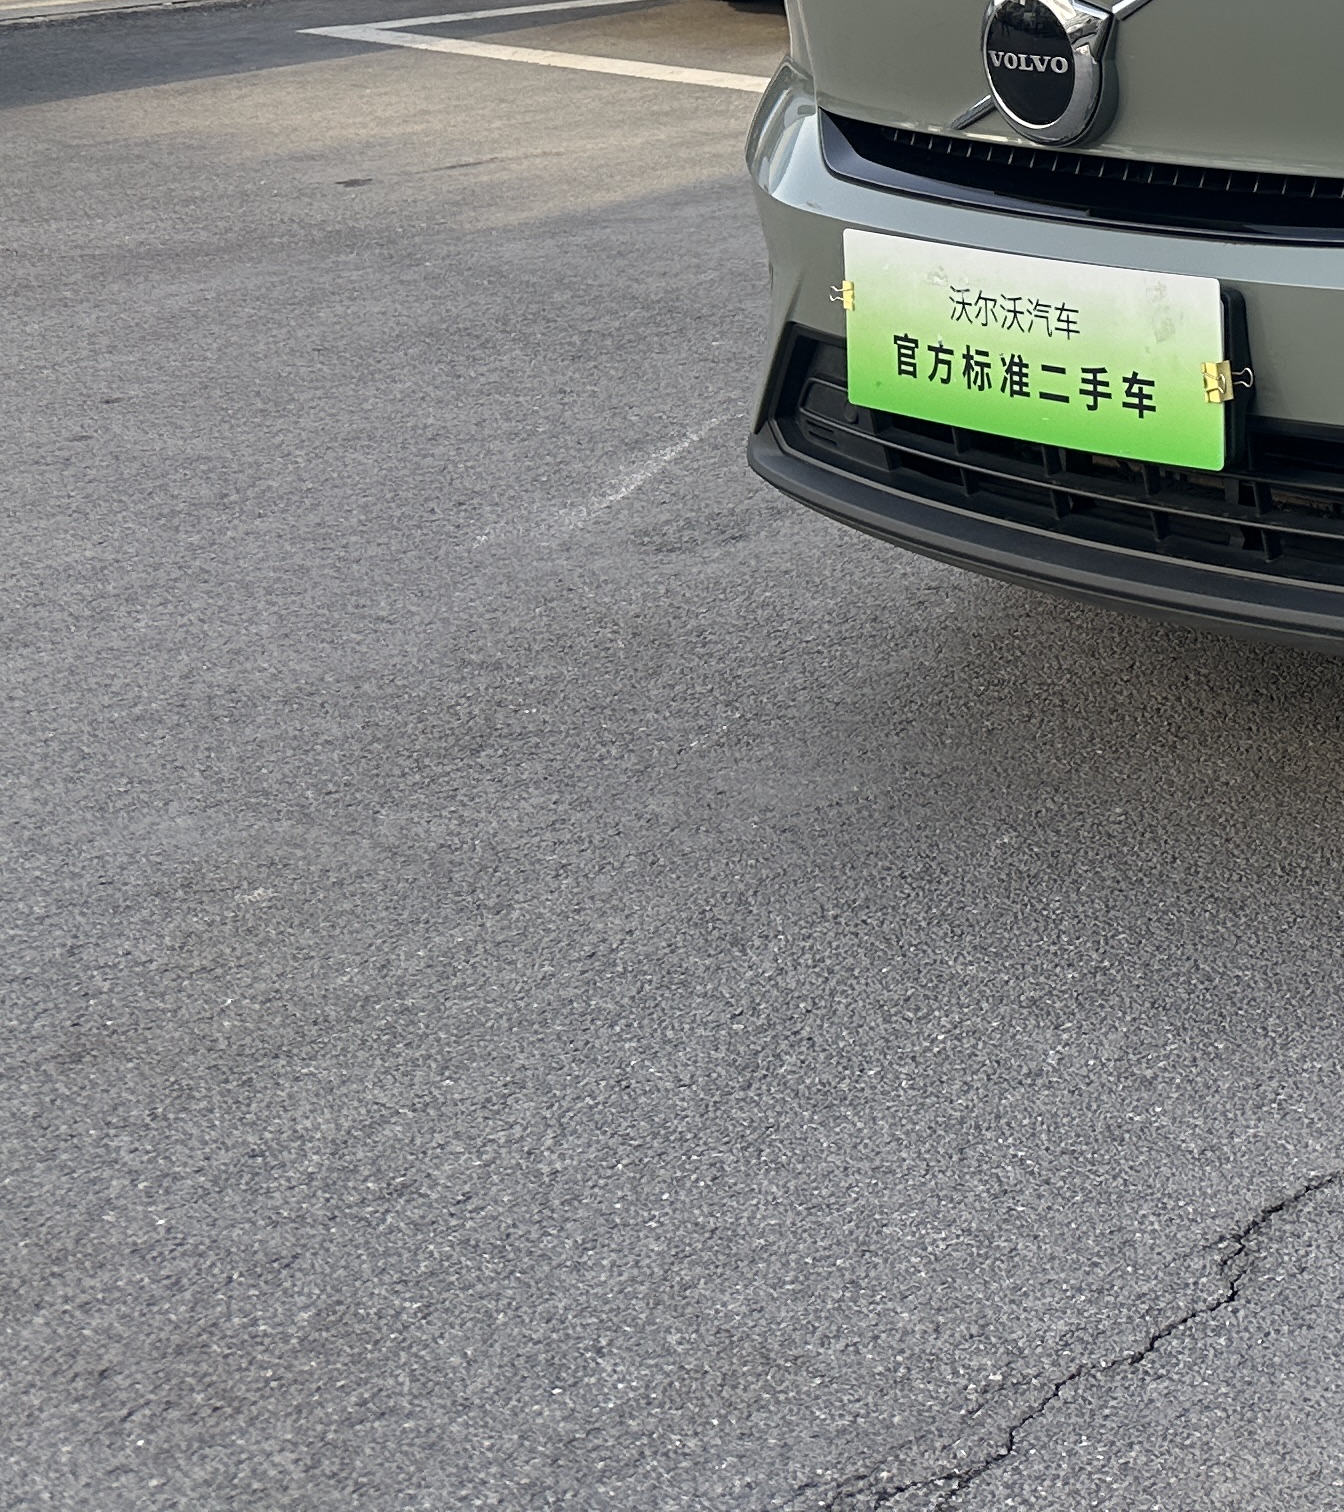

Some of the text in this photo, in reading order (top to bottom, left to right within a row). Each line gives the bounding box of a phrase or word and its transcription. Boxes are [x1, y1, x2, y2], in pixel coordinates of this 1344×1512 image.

[988, 50, 1069, 74] VOLVO
[949, 285, 1080, 340] 沃尔沃汽车
[893, 333, 1157, 419] 官方标准二手车
